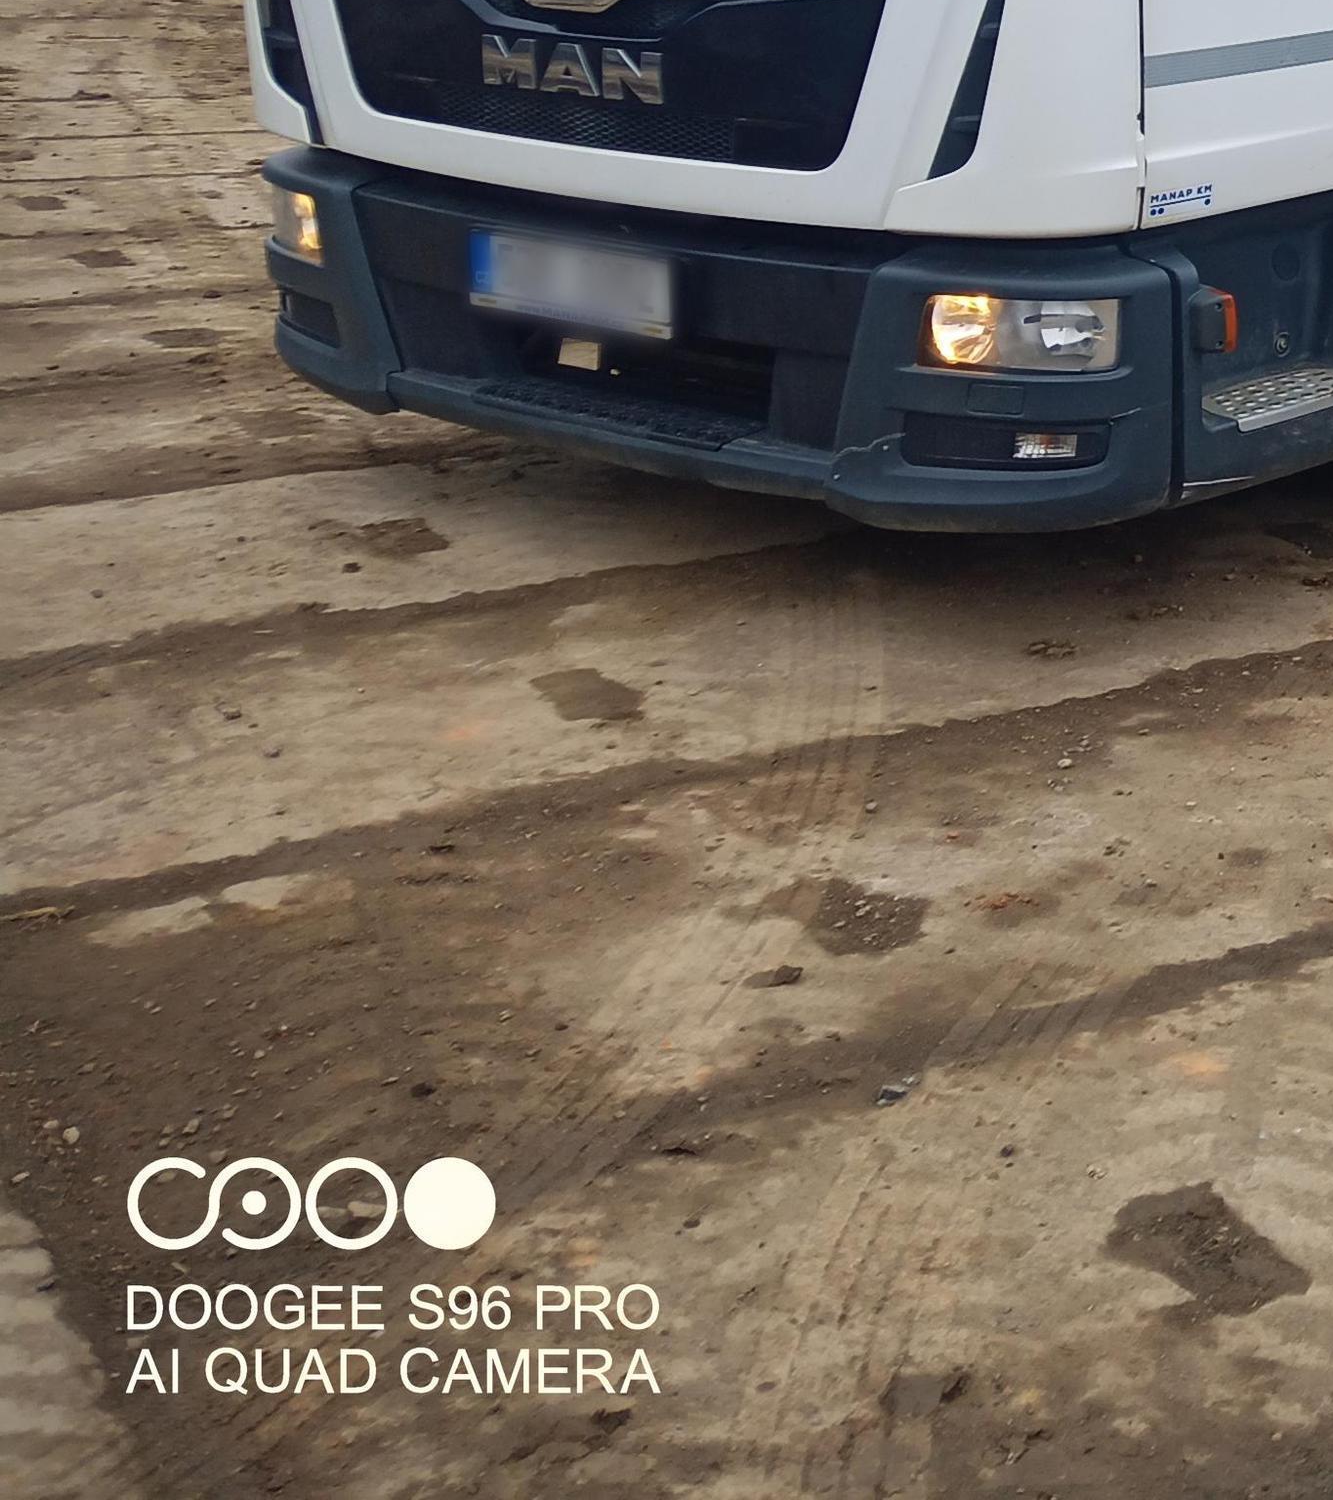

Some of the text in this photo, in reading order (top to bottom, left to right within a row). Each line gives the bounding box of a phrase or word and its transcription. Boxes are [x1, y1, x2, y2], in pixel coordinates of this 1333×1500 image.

[481, 34, 664, 105] MAN
[1150, 184, 1212, 204] MANAP KM
